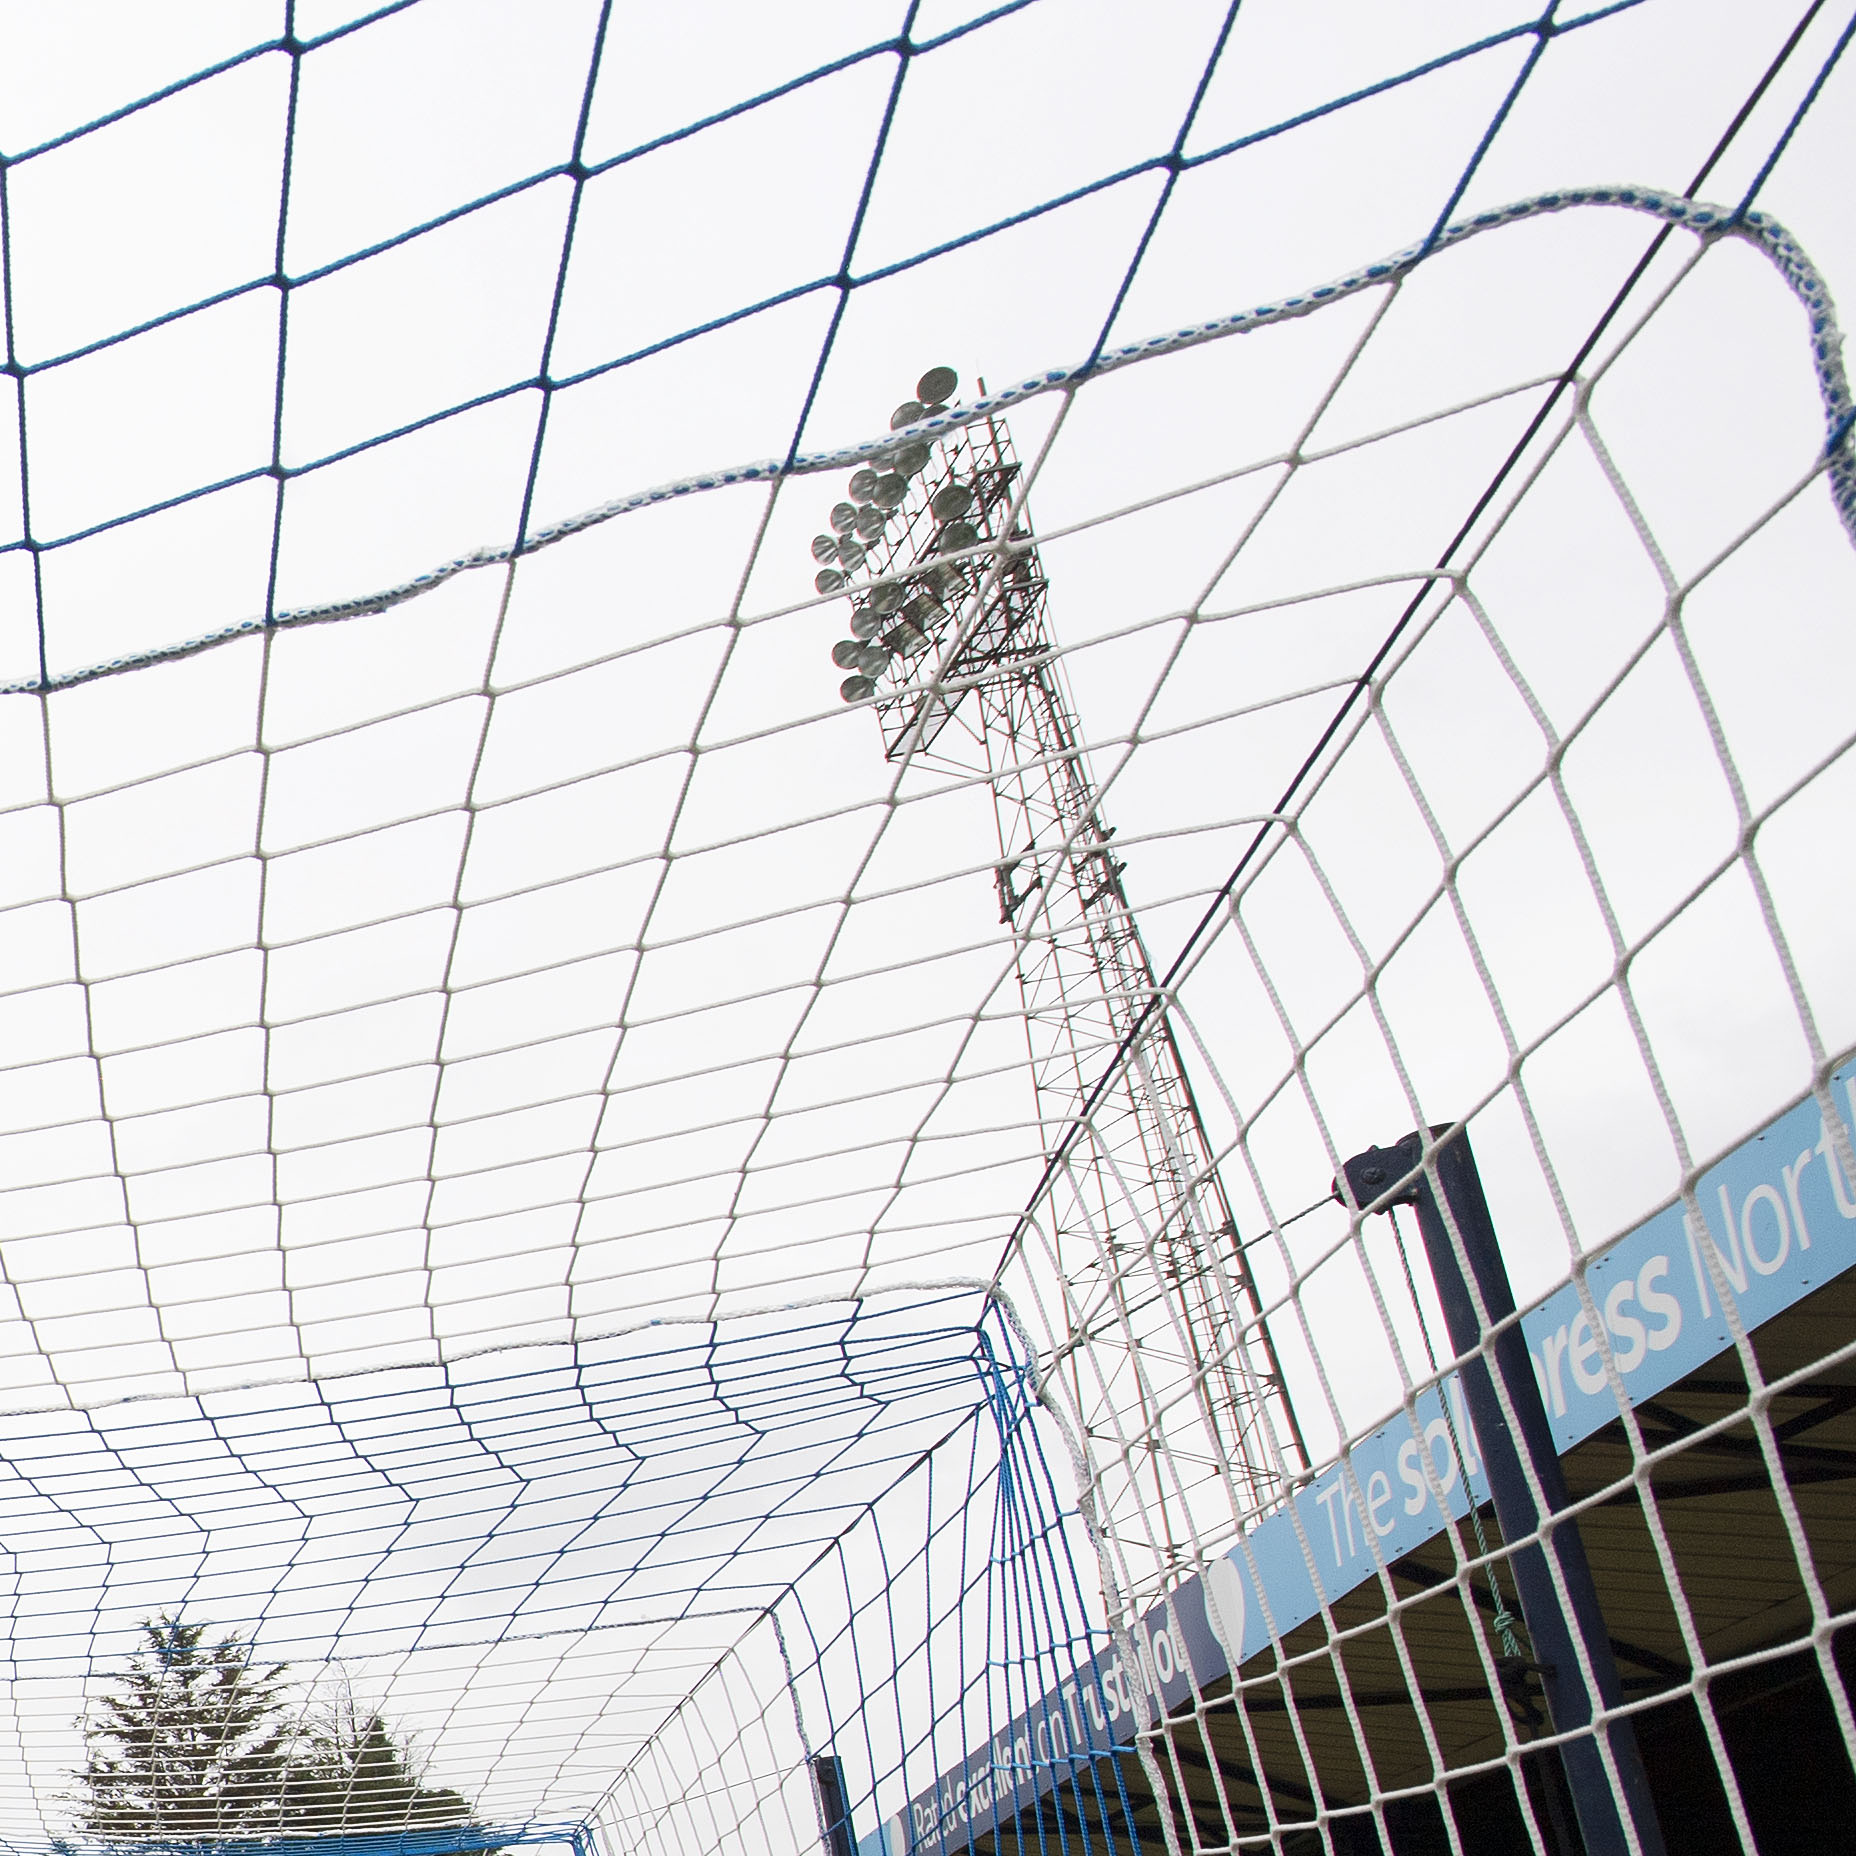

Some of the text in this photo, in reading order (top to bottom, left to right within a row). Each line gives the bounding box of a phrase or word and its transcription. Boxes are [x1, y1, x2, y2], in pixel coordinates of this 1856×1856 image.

[1315, 1467, 1397, 1568] The
[1683, 1077, 1856, 1319] Nort
[1063, 1619, 1190, 1745] Trustilot
